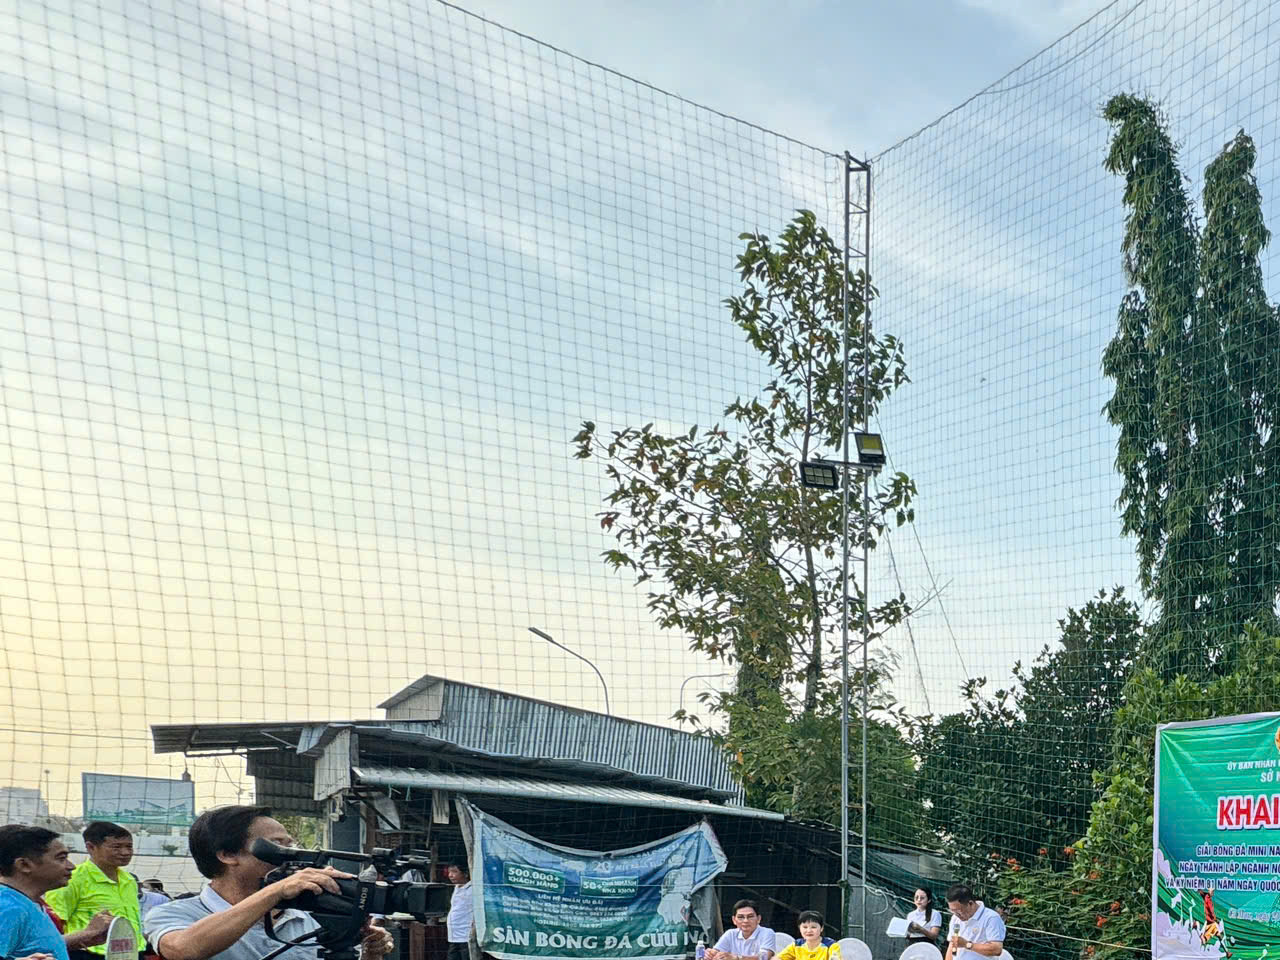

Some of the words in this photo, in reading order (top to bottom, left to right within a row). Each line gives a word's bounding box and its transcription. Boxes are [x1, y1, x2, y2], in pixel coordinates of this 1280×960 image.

[1260, 769, 1273, 783] SỞ
[1218, 795, 1280, 828] KHAI
[1213, 843, 1233, 856] BÓNG
[1235, 843, 1246, 856] ĐÁ
[1248, 845, 1267, 856] MINI
[508, 867, 560, 882] 500.000+
[1179, 859, 1198, 872] NGÀY
[1200, 860, 1223, 873] THÀNH
[1225, 860, 1240, 875] LẬP
[1242, 860, 1269, 874] NGÀNH
[1217, 877, 1235, 890] NĂM
[1236, 877, 1258, 892] NGÀY
[359, 887, 368, 910] SONY
[493, 925, 530, 946] SÂN
[535, 929, 598, 949] BÓNG
[604, 931, 632, 949] ĐÁ
